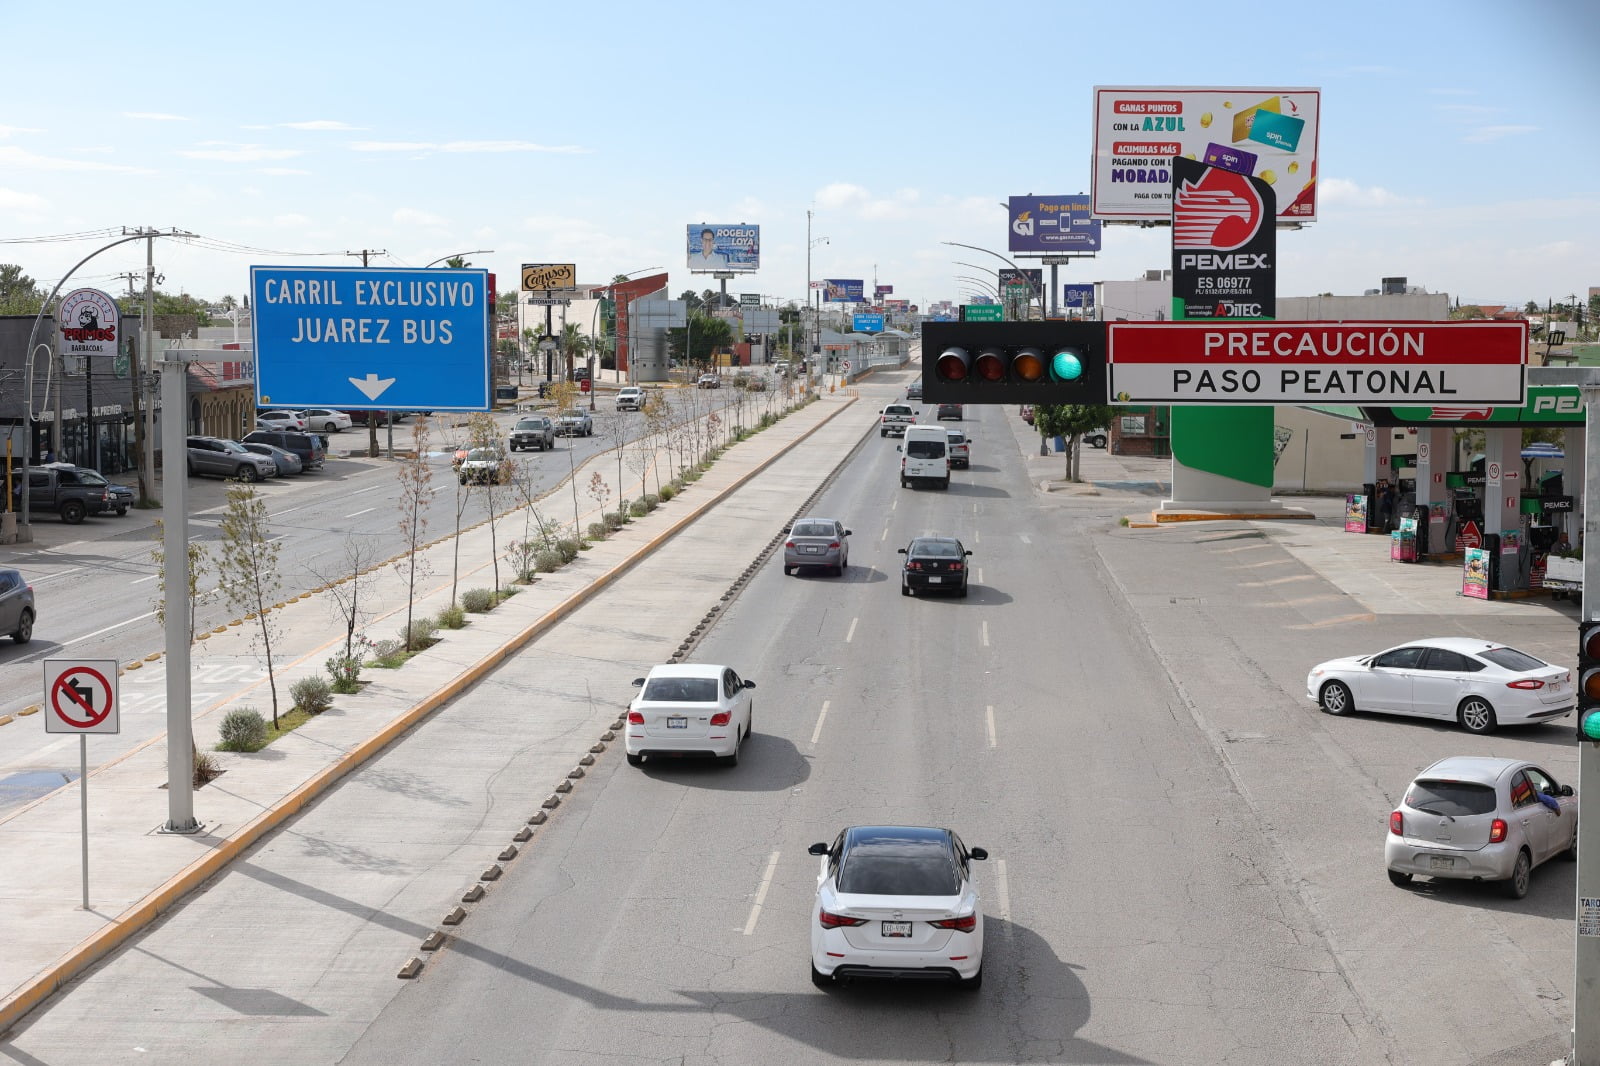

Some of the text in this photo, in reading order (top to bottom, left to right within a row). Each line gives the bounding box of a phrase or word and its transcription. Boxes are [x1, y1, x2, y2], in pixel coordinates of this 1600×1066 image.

[1119, 104, 1178, 113] GANAS PUNTOS
[1113, 116, 1186, 132] CON LA AZUL
[1117, 144, 1177, 154] ACUMULAS MÁS
[1111, 158, 1172, 167] PAGANDO CON L
[1222, 153, 1239, 164] spin
[1111, 168, 1172, 184] MORAD
[1134, 192, 1150, 200] PAGA
[1151, 192, 1163, 200] CON
[1039, 202, 1059, 214] Pago
[1060, 204, 1071, 212] en
[716, 228, 755, 237] ROGELIO
[731, 237, 754, 246] LOYA
[1181, 253, 1268, 270] PEMEX
[1198, 277, 1251, 289] ES 06977
[265, 279, 474, 307] CARRIL EXCLUSIVO
[60, 324, 115, 343] PRIMOS
[291, 318, 453, 345] JUAREZ BUS
[1204, 328, 1425, 356] PRECAUCIÓN
[71, 344, 104, 352] BARBACOAS
[1174, 369, 1457, 394] PASO PEATONAL
[1491, 466, 1498, 474] 10
[1544, 501, 1571, 509] PEMEX
